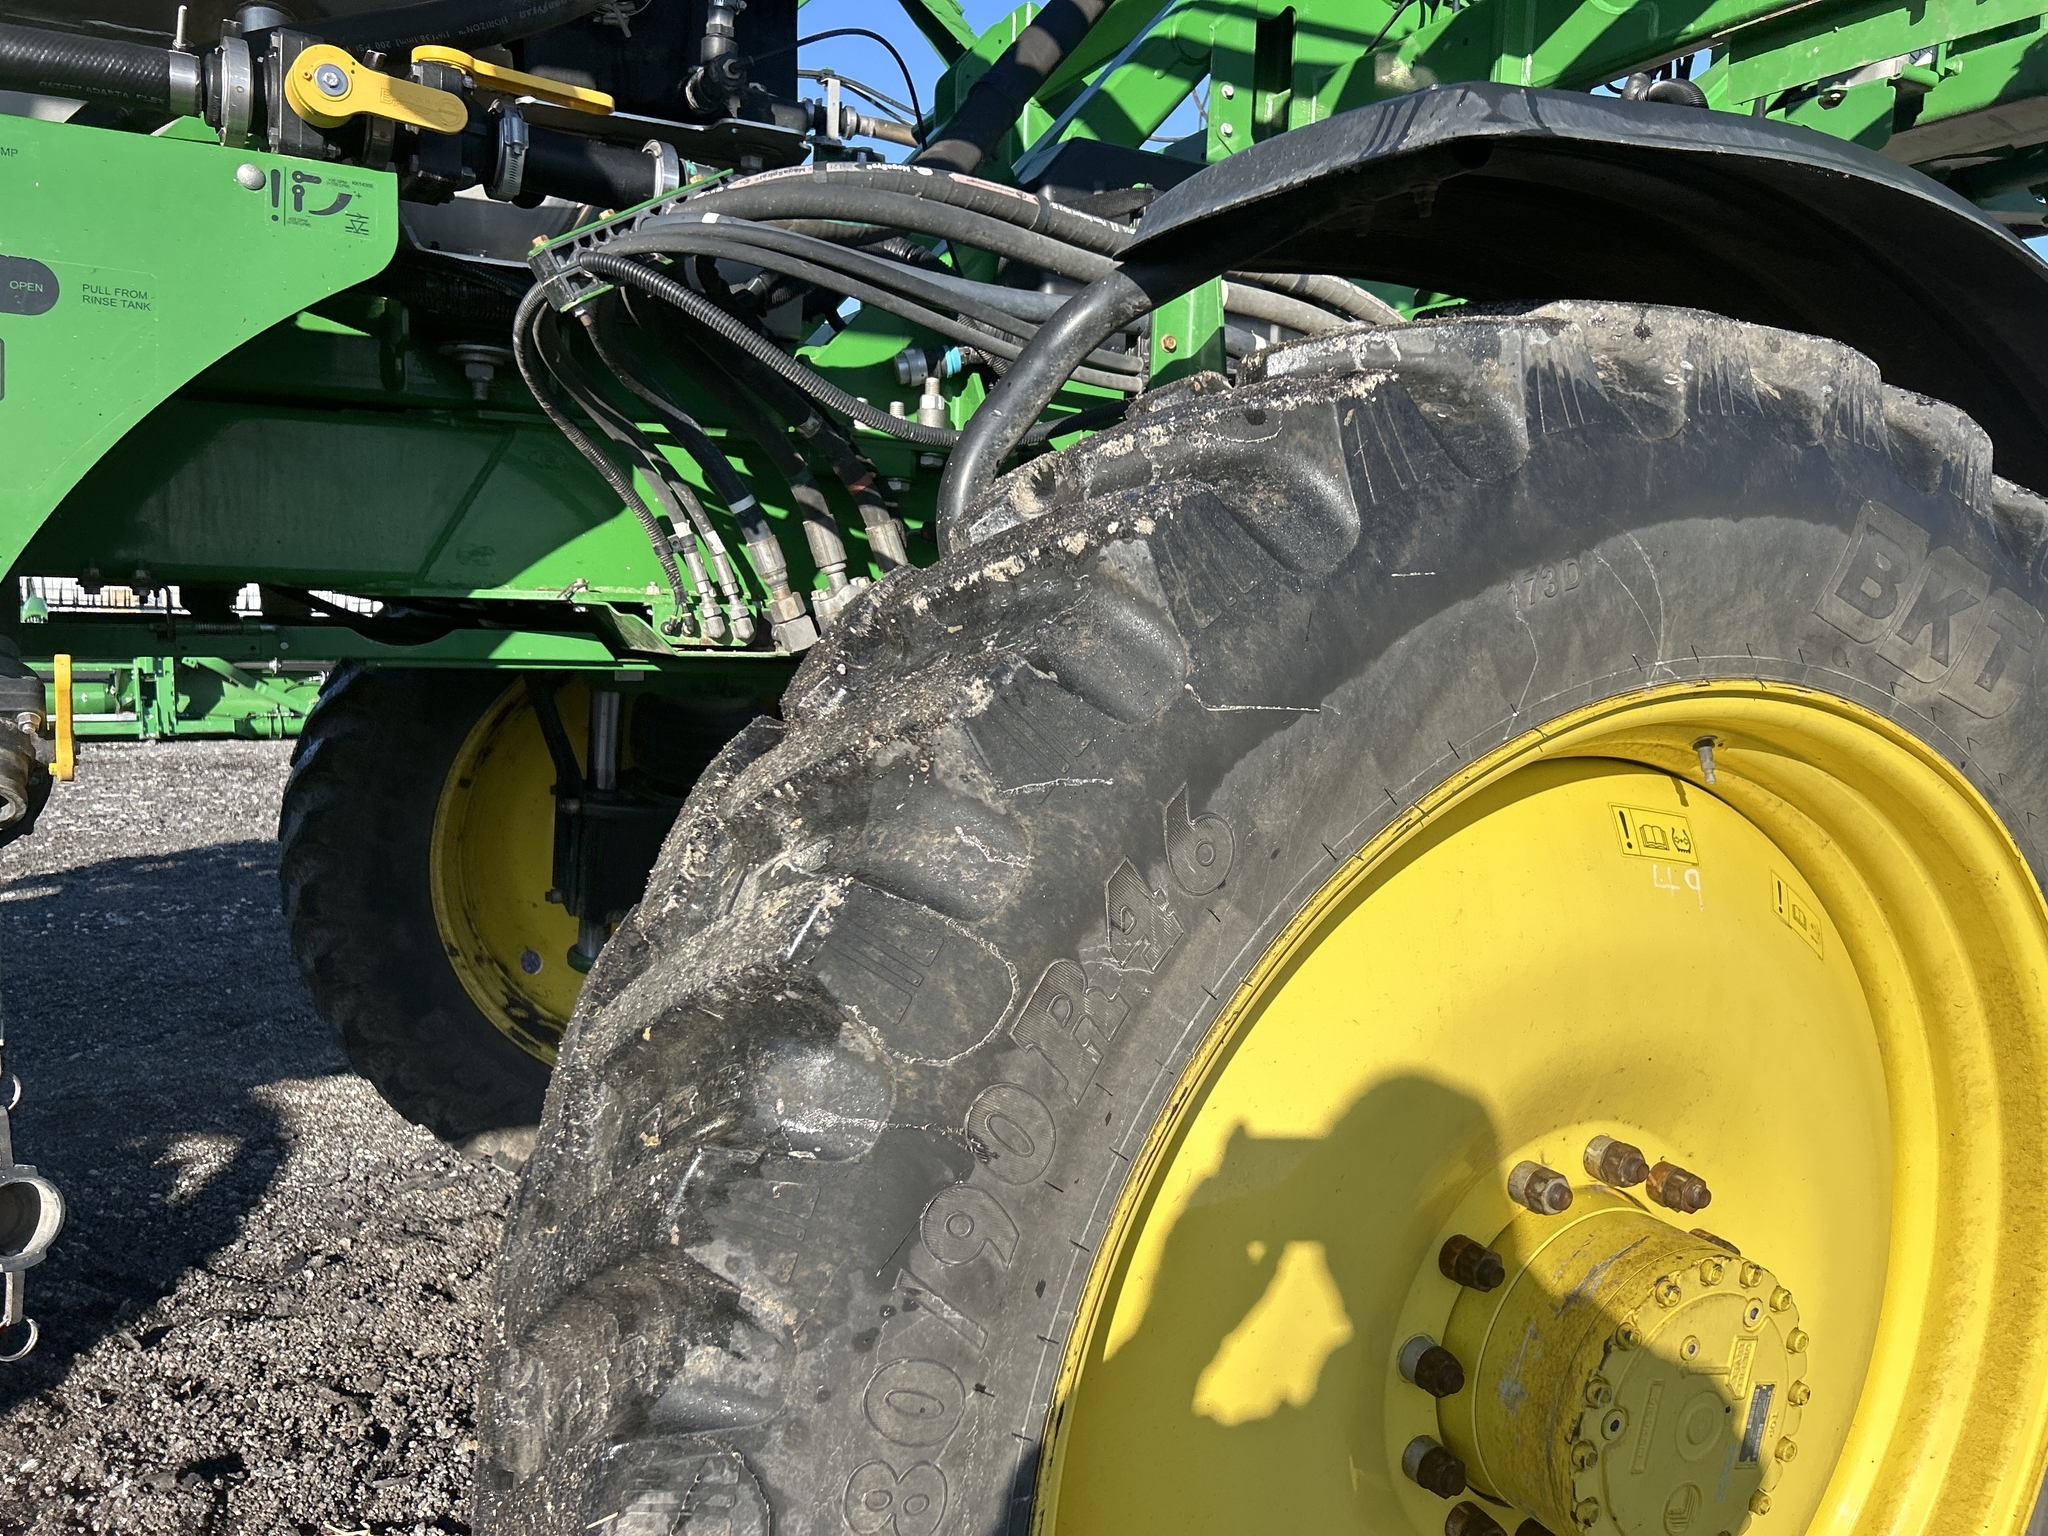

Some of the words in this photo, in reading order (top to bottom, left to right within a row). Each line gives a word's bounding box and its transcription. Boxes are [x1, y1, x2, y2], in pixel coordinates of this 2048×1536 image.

[519, 0, 572, 19] OODYEAR
[375, 40, 391, 50] 200
[9, 280, 44, 293] OPEN
[82, 283, 111, 296] PULL
[114, 287, 148, 300] FROM
[82, 294, 118, 308] RINSE
[121, 299, 152, 312] TANK
[1830, 517, 2037, 700] BKT
[1652, 864, 1705, 912] 49
